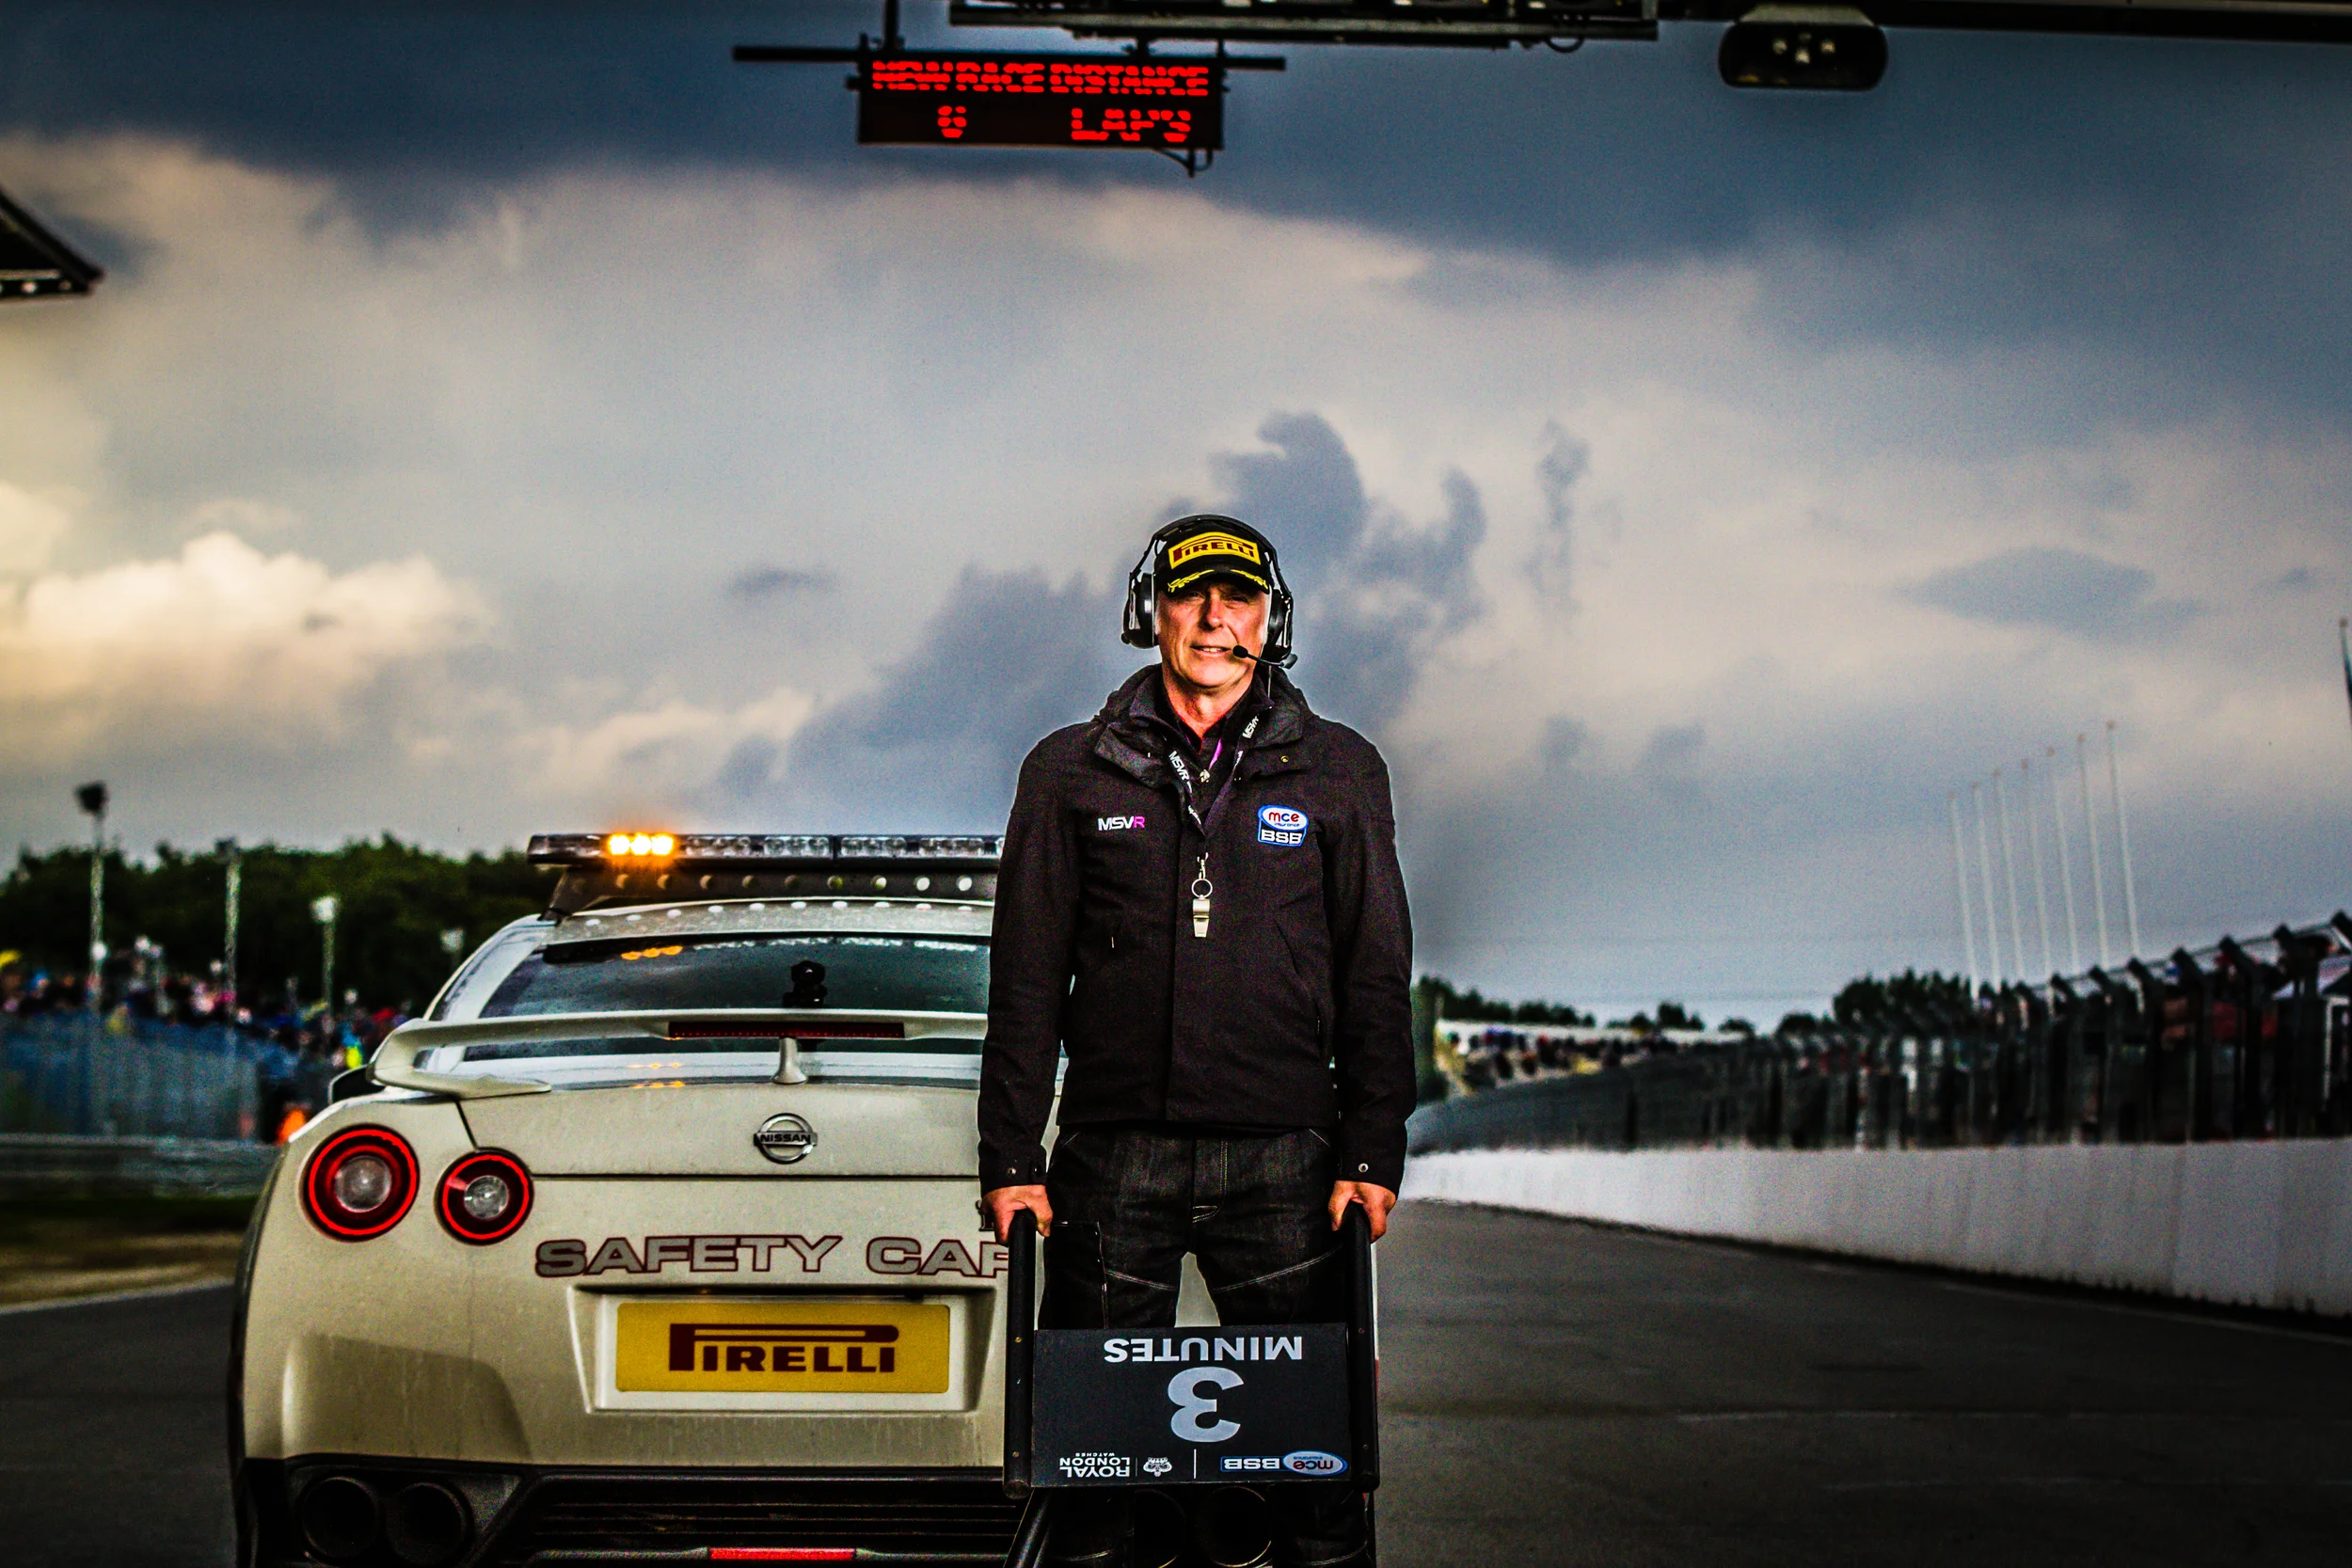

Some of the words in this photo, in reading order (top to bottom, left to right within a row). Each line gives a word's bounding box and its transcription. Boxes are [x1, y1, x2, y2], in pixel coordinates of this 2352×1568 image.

[872, 60, 953, 91] NEW
[956, 62, 1044, 92] RACE
[1050, 64, 1208, 96] DISTANCE
[1071, 107, 1191, 142] LAPS
[1172, 535, 1255, 562] PIRELLI
[1168, 751, 1190, 781] MSVR
[1097, 816, 1145, 832] MSVR
[1268, 812, 1300, 822] mce
[1261, 829, 1303, 845] BSB
[759, 1133, 811, 1143] NISSAN
[534, 1234, 842, 1277] SAFETY
[669, 1323, 899, 1373] PIRELLI
[1104, 1336, 1303, 1363] MINUTES
[1168, 1366, 1245, 1443] 3
[1059, 1457, 1131, 1466] LONDON
[1059, 1465, 1131, 1478] ROYAL
[1223, 1458, 1280, 1470] BSB
[1293, 1460, 1334, 1470] mce
